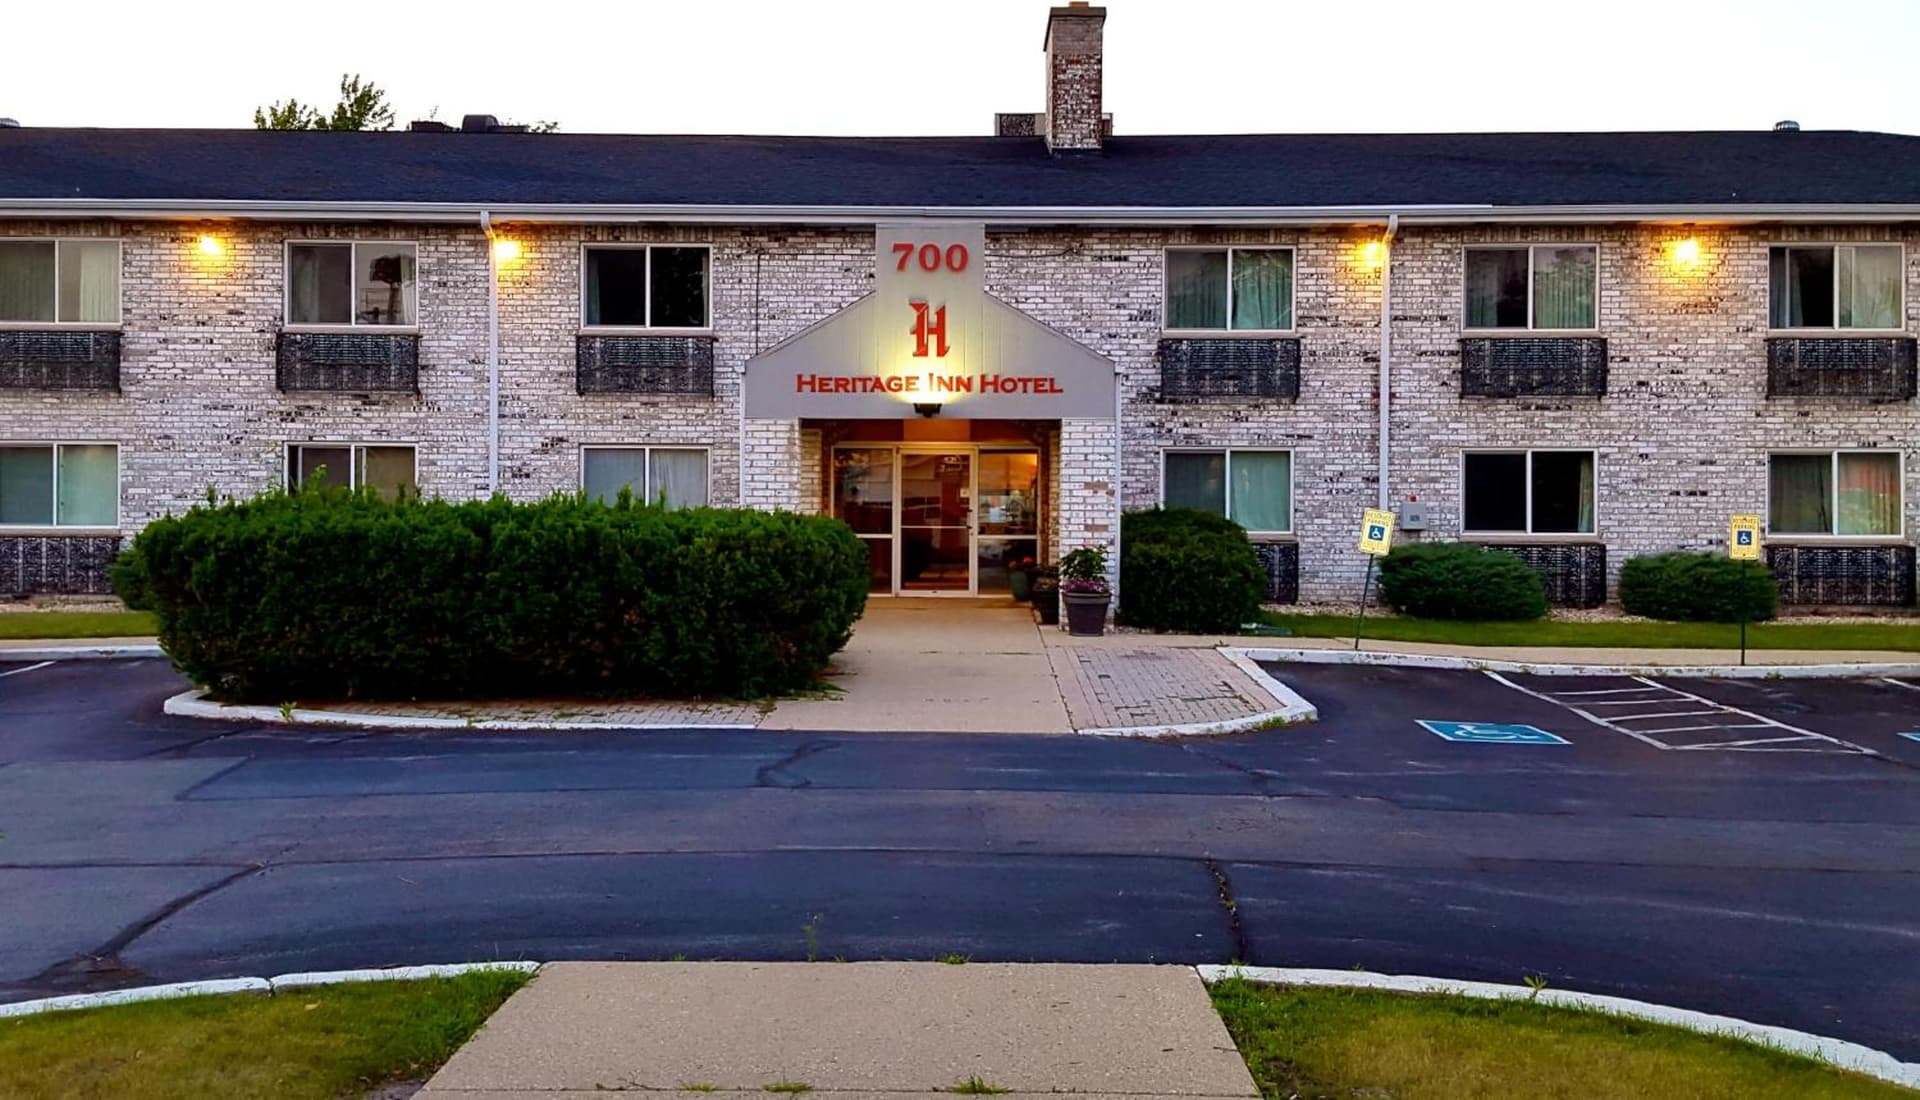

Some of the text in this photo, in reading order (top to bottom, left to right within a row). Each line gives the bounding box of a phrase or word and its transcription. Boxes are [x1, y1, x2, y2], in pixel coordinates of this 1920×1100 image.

[892, 243, 969, 272] 700
[909, 302, 950, 357] H
[796, 374, 1064, 394] HERITAGE INN HOTEL
